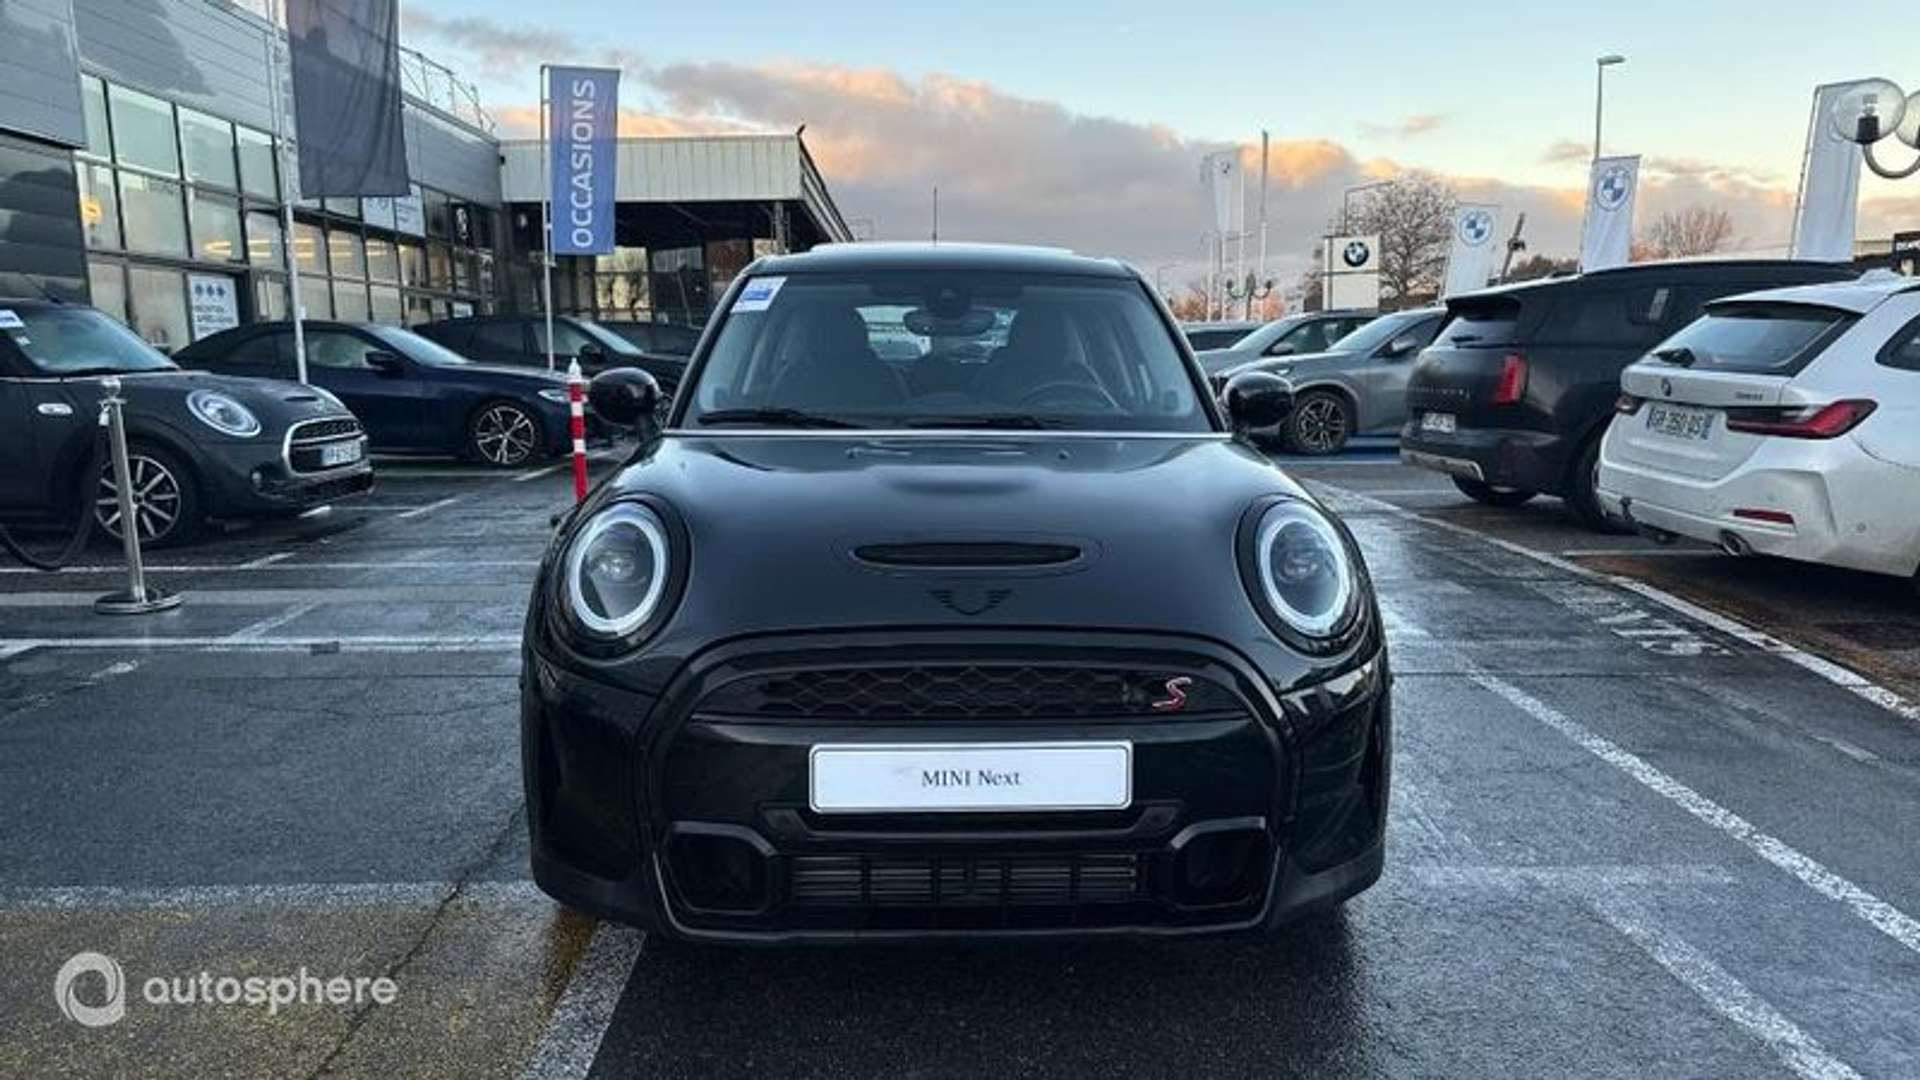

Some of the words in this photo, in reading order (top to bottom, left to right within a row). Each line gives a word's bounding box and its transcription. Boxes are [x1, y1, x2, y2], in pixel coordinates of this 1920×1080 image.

[571, 79, 596, 248] OCCASIONS
[1152, 676, 1192, 713] S
[922, 769, 971, 788] MINI
[978, 769, 1020, 787] Next
